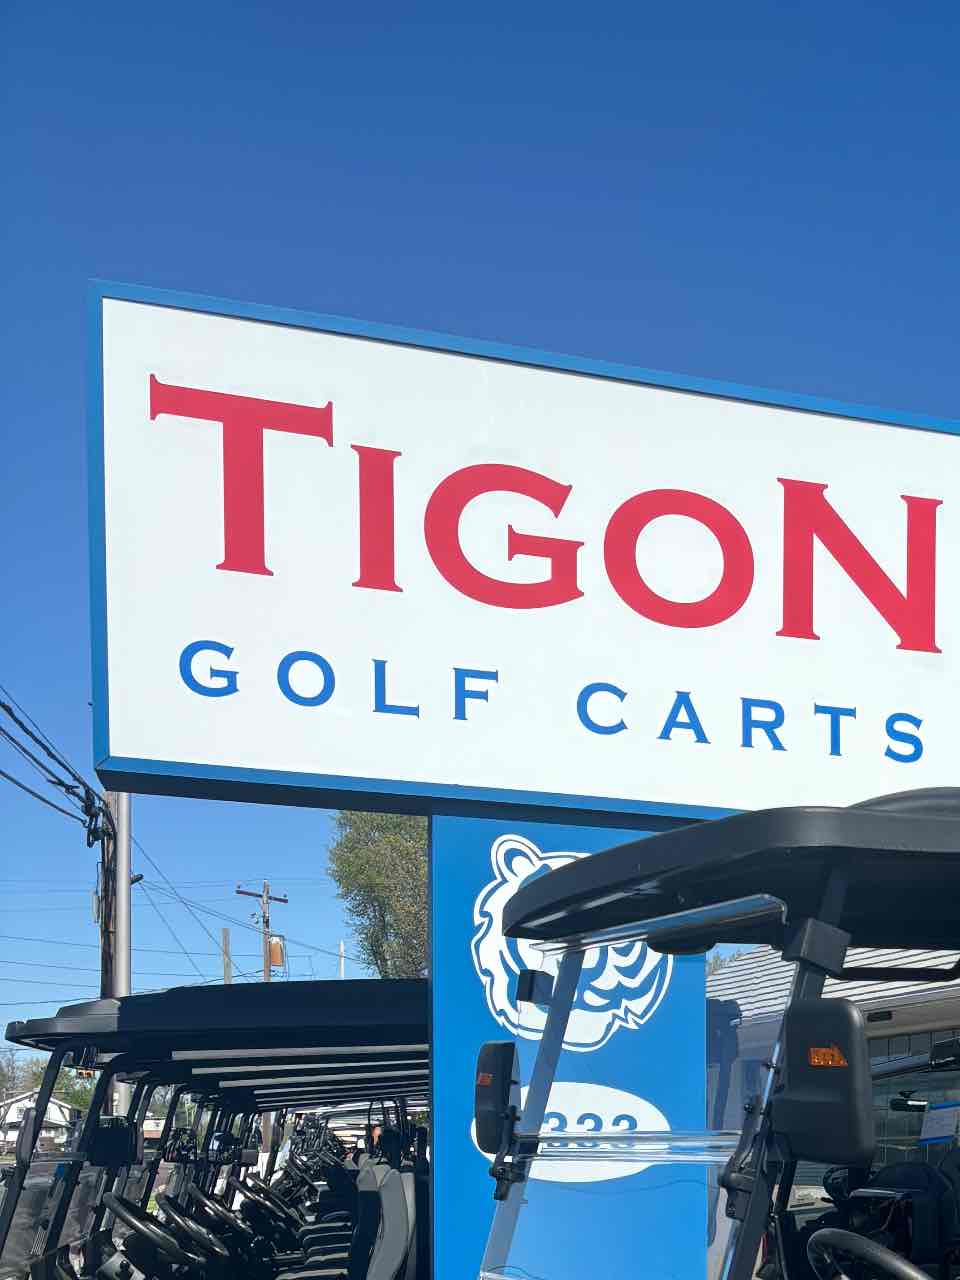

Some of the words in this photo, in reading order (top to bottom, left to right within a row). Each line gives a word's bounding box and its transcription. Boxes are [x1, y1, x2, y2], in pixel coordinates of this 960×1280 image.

[150, 374, 942, 654] TIGON
[179, 640, 498, 722] GOLF
[577, 683, 924, 764] CARTS
